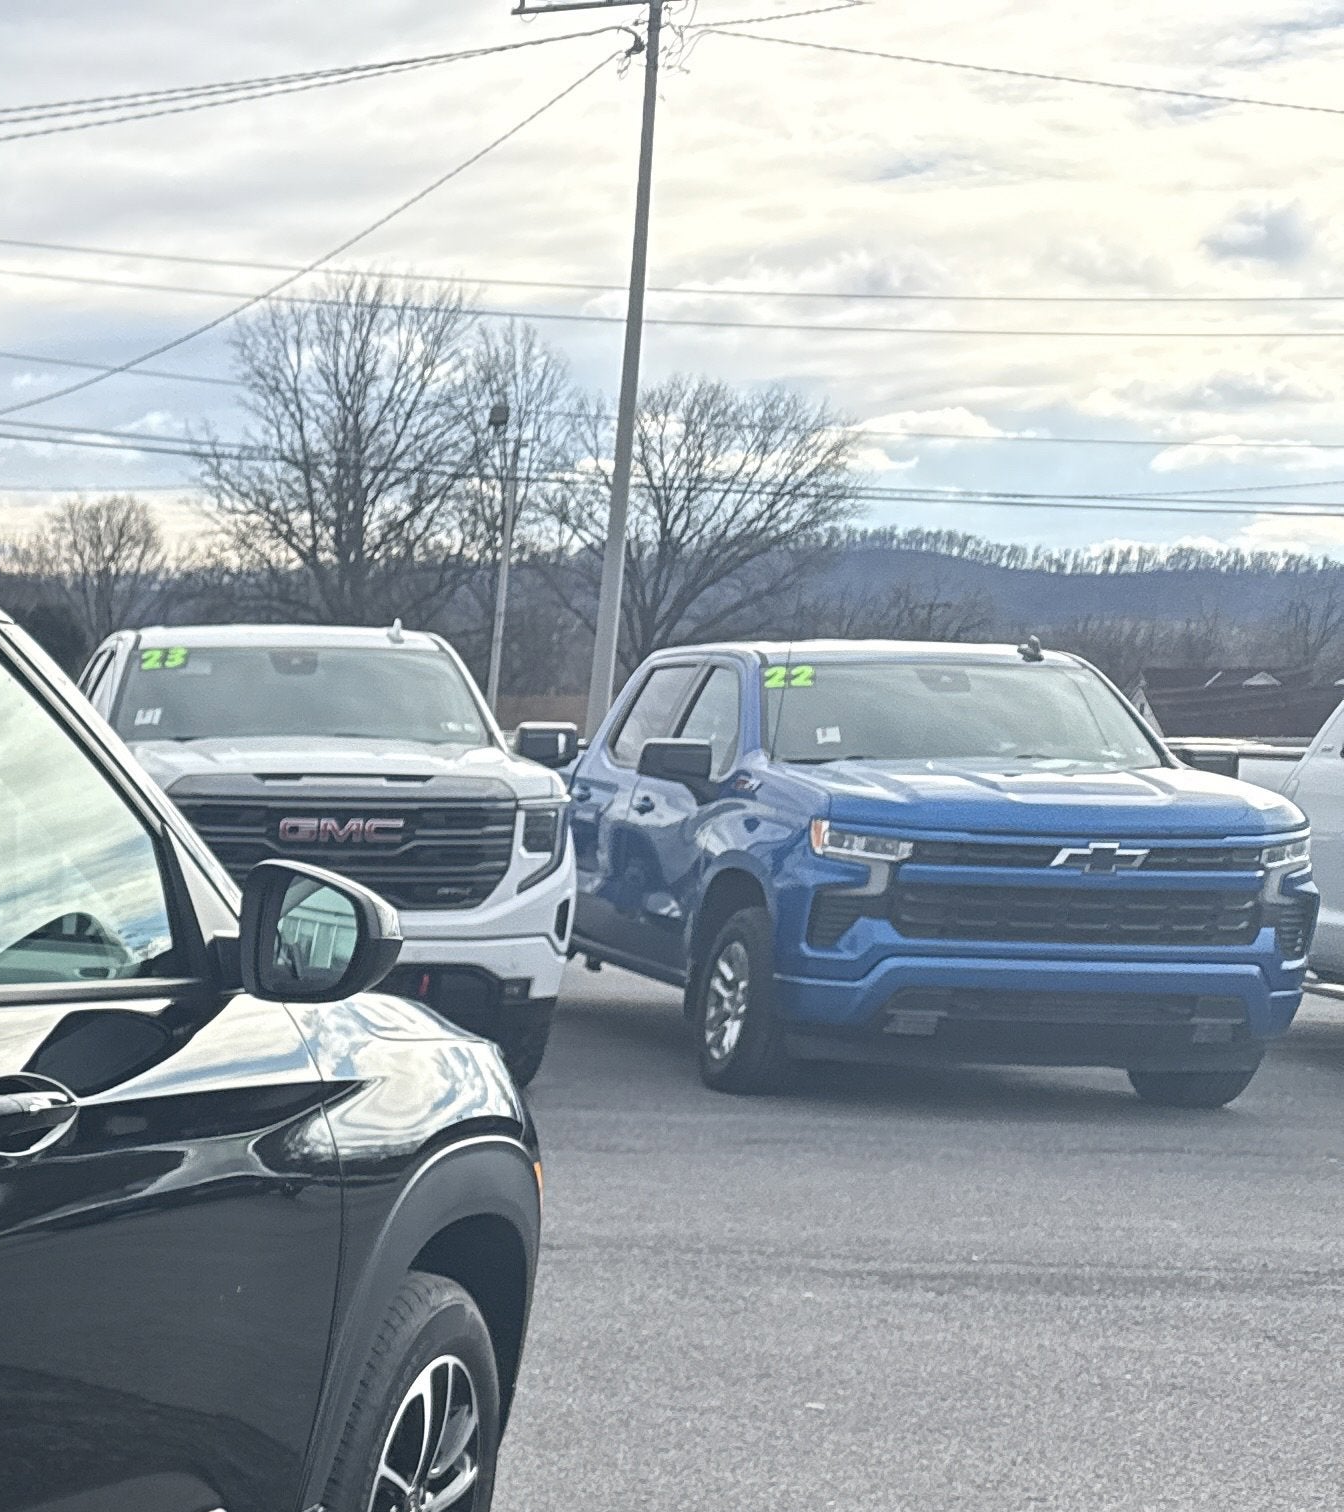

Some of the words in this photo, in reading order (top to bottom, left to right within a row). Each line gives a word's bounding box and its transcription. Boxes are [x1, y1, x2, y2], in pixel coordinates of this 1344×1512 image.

[140, 645, 188, 671] 23
[764, 665, 815, 688] 22
[279, 817, 405, 842] GMC
